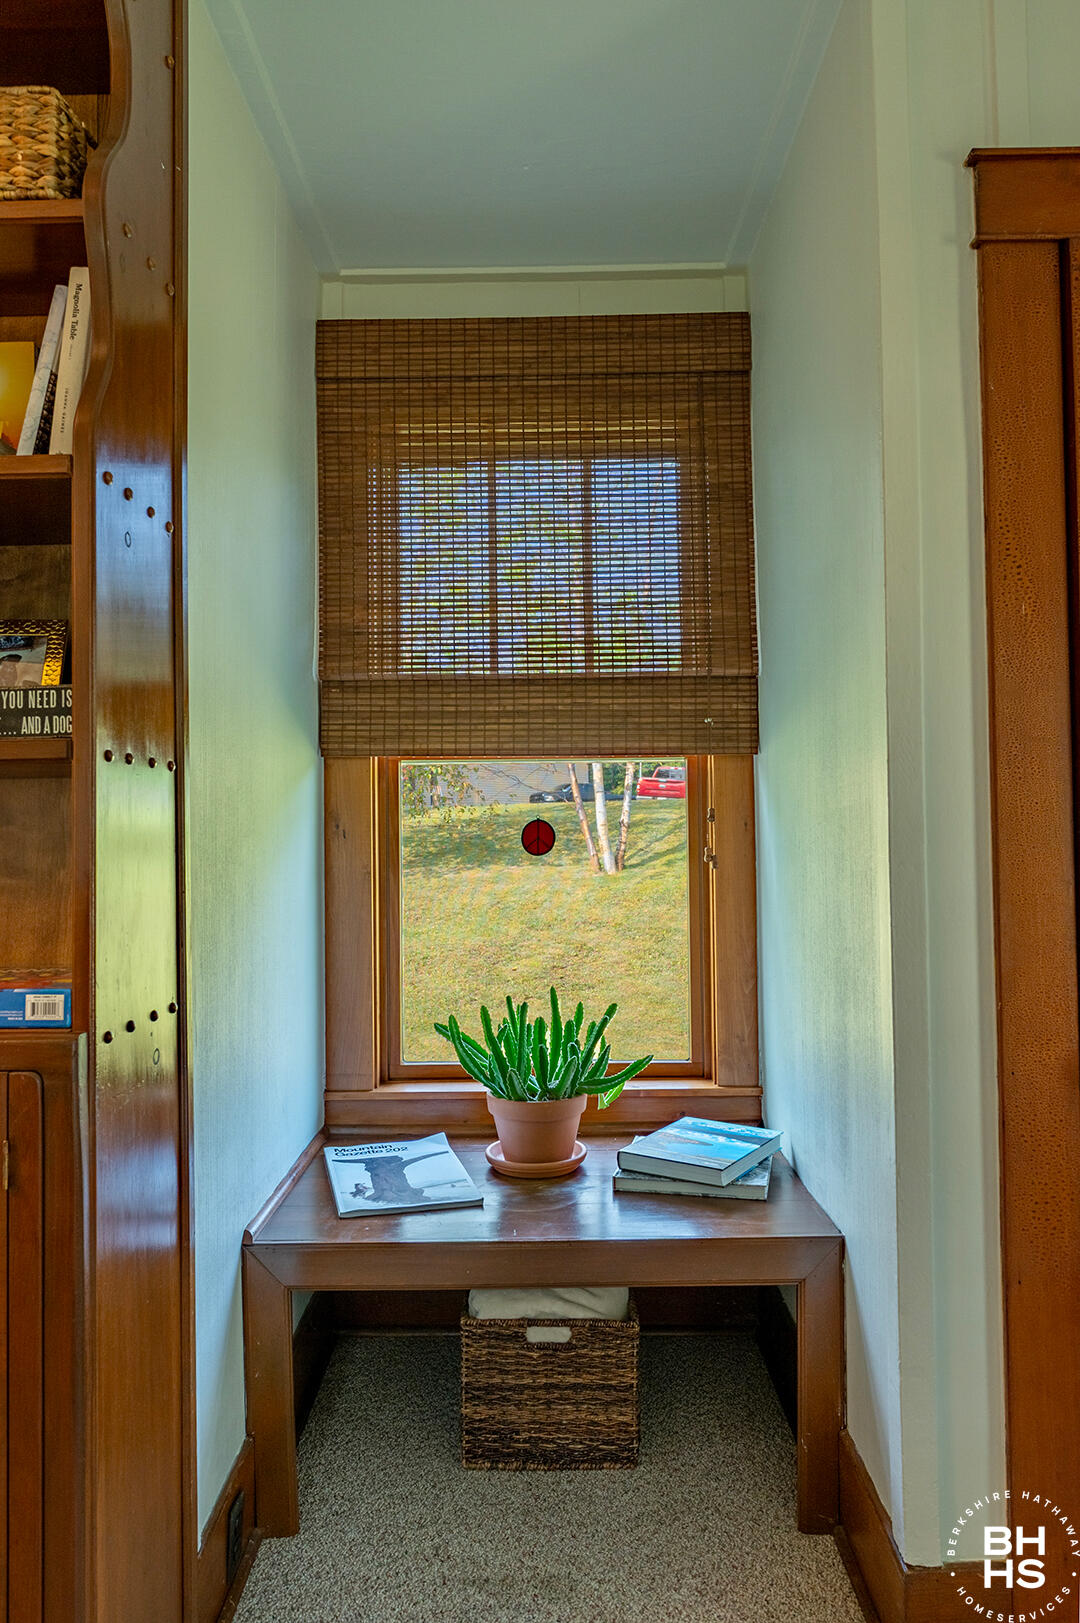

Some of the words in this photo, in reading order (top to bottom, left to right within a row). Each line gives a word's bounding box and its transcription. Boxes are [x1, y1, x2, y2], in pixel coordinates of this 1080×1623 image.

[72, 283, 83, 318] Magnolia
[69, 320, 79, 340] Table
[1, 690, 24, 709] YOU
[28, 689, 57, 709] NEED
[61, 689, 72, 708] IS
[21, 716, 41, 735] AND
[43, 715, 51, 734] A
[53, 715, 72, 734] DOG
[334, 1144, 393, 1153] Mountain
[334, 1149, 384, 1157] Gazette
